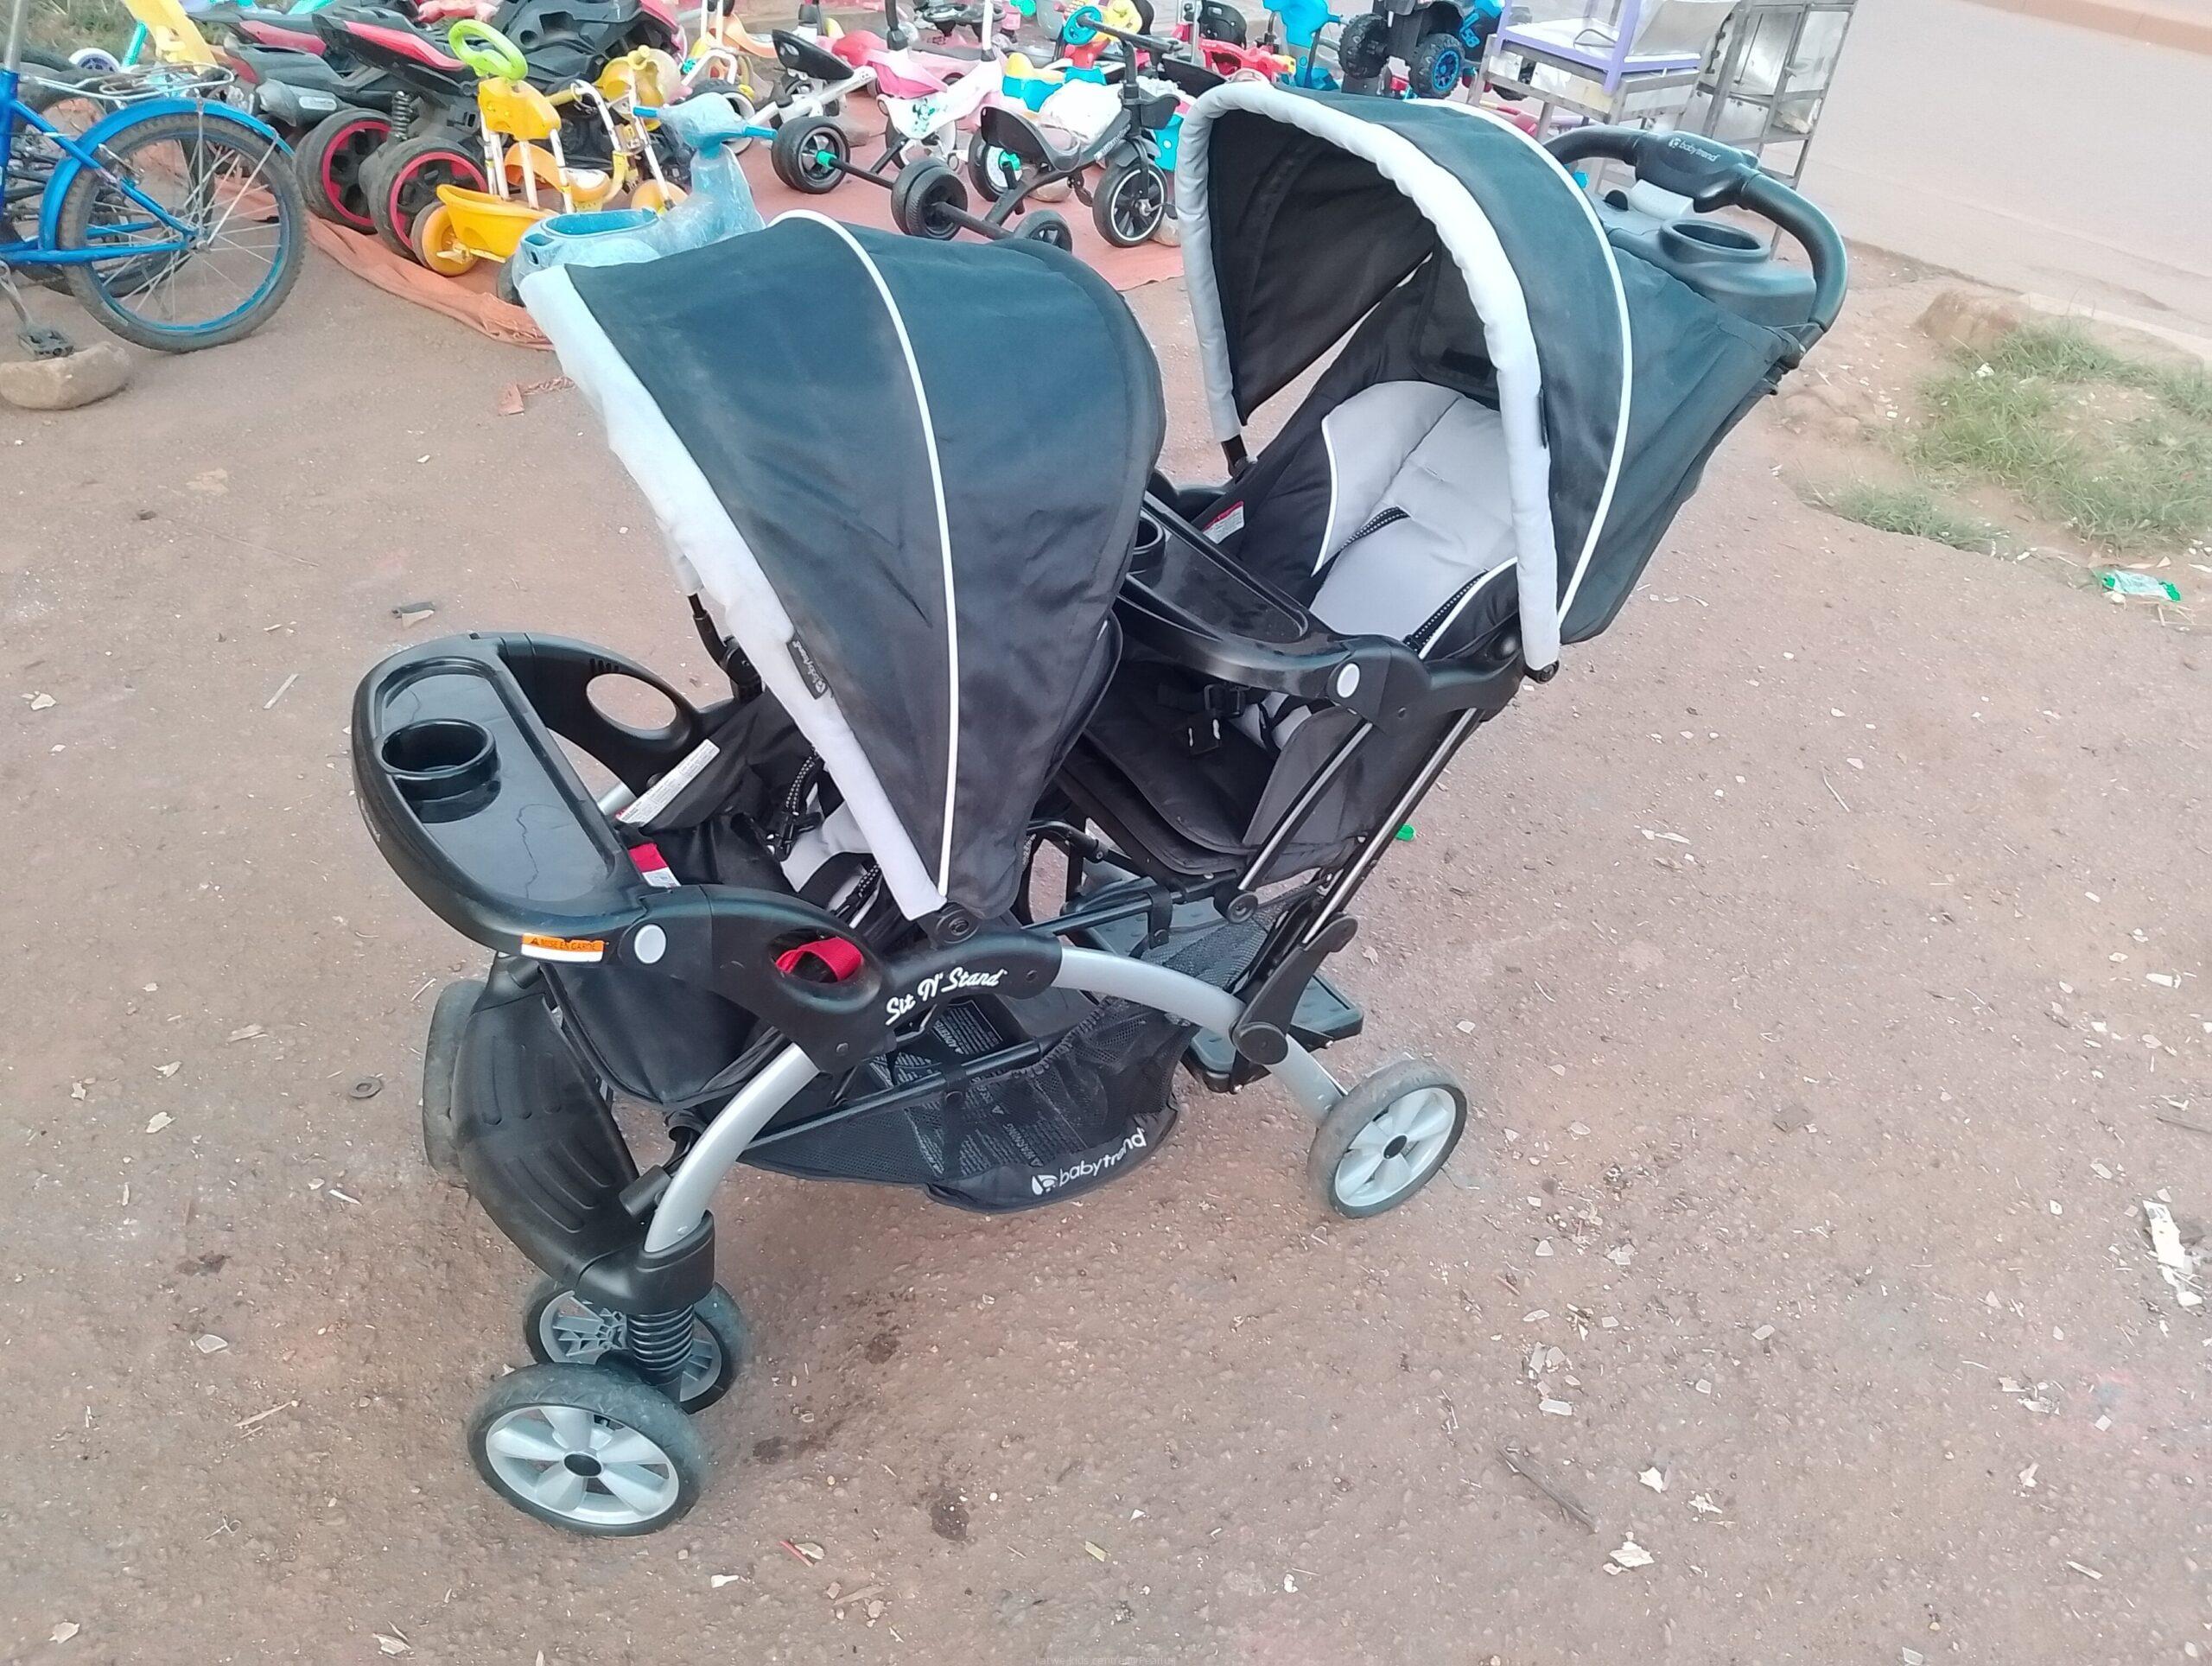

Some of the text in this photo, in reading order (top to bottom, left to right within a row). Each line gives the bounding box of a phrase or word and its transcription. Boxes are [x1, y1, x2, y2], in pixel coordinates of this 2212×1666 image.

[1679, 139, 1719, 162] babytrend
[540, 938, 558, 949] MISE
[571, 941, 597, 951] GARDE
[885, 994, 916, 1026] Sit
[940, 966, 1004, 993] Stand
[932, 1019, 959, 1047] ADVERTE
[1002, 1122, 1036, 1160] WARNING
[1059, 1127, 1147, 1187] babytrend
